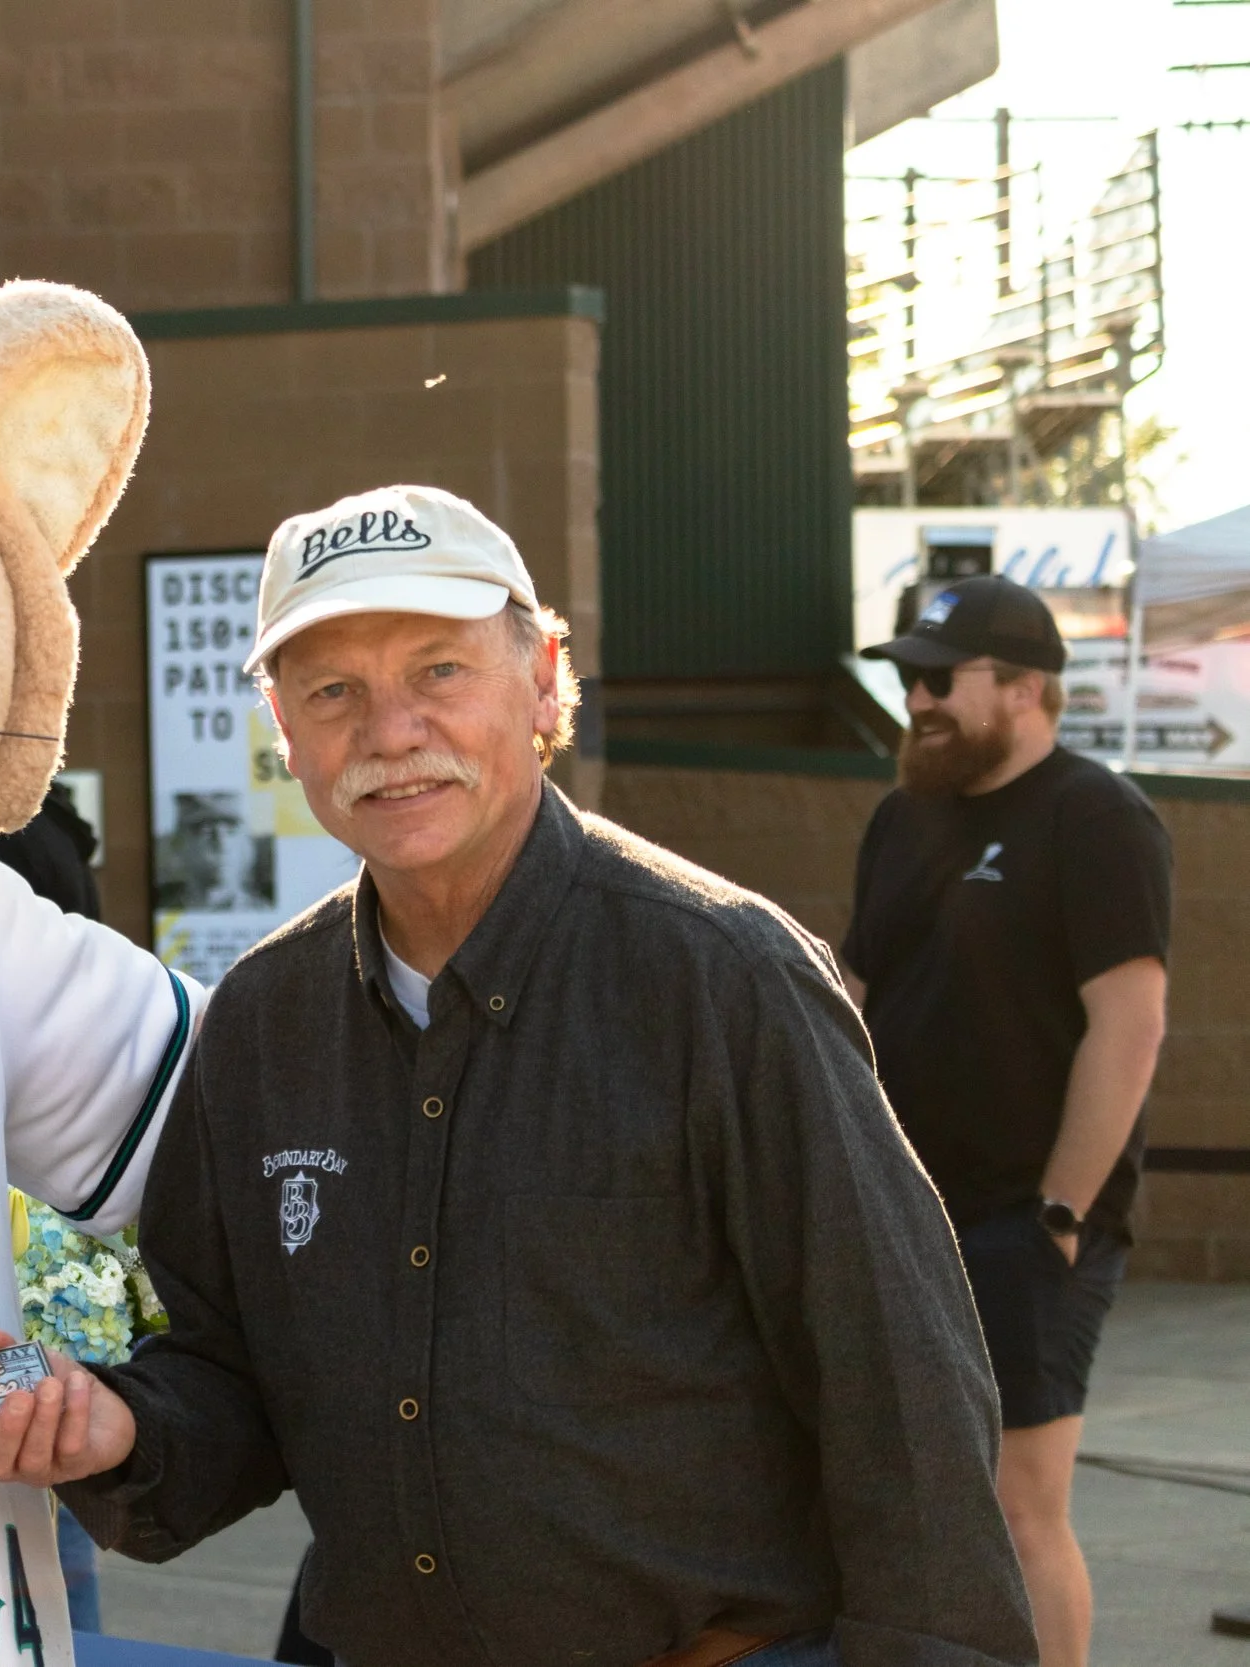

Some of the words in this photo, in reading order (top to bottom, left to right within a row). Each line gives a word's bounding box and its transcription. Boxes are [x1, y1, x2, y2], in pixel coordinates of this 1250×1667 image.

[298, 510, 426, 571] Bells
[162, 571, 261, 607] DISC
[190, 706, 234, 742] TO
[0, 1346, 31, 1362] BAY
